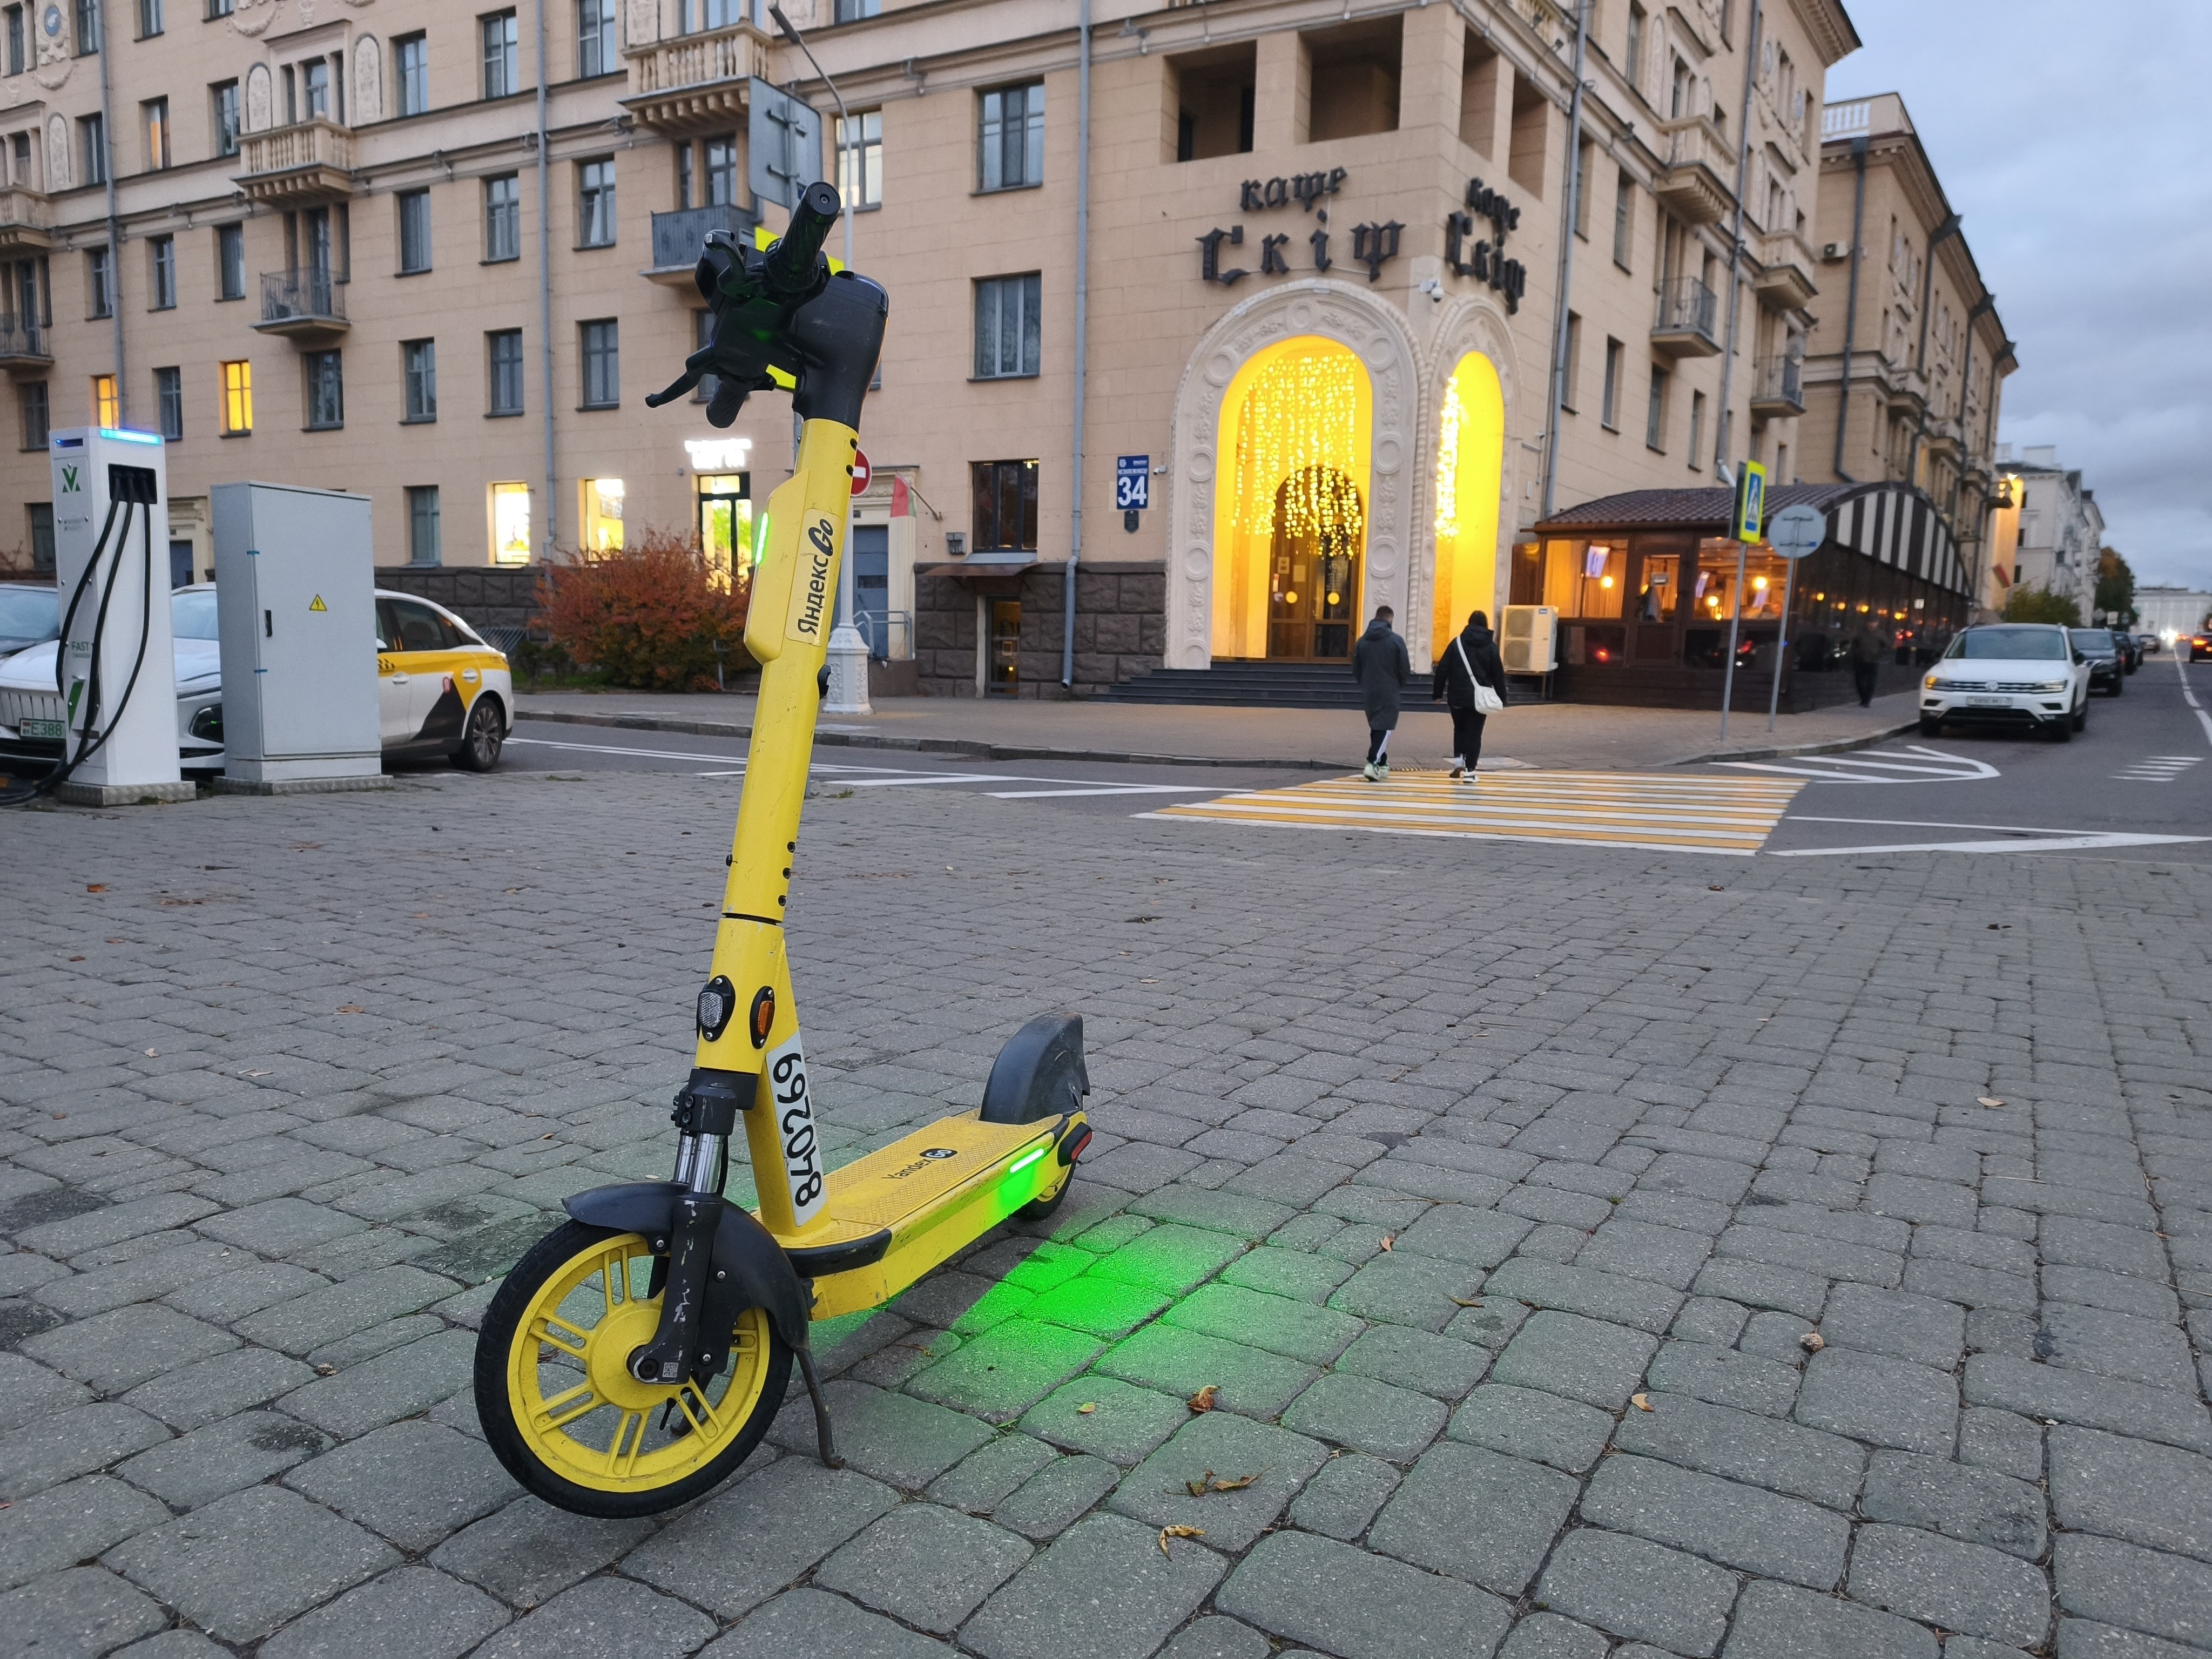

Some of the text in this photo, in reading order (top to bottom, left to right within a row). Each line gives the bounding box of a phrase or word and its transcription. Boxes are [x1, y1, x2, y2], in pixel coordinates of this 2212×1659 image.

[1195, 209, 1406, 286] Скіф
[1118, 476, 1147, 506] 34
[798, 518, 834, 637] Яндекс Go
[72, 641, 90, 651] FAST
[773, 1053, 822, 1207] 840269
[881, 1150, 952, 1179] Yandex Go
